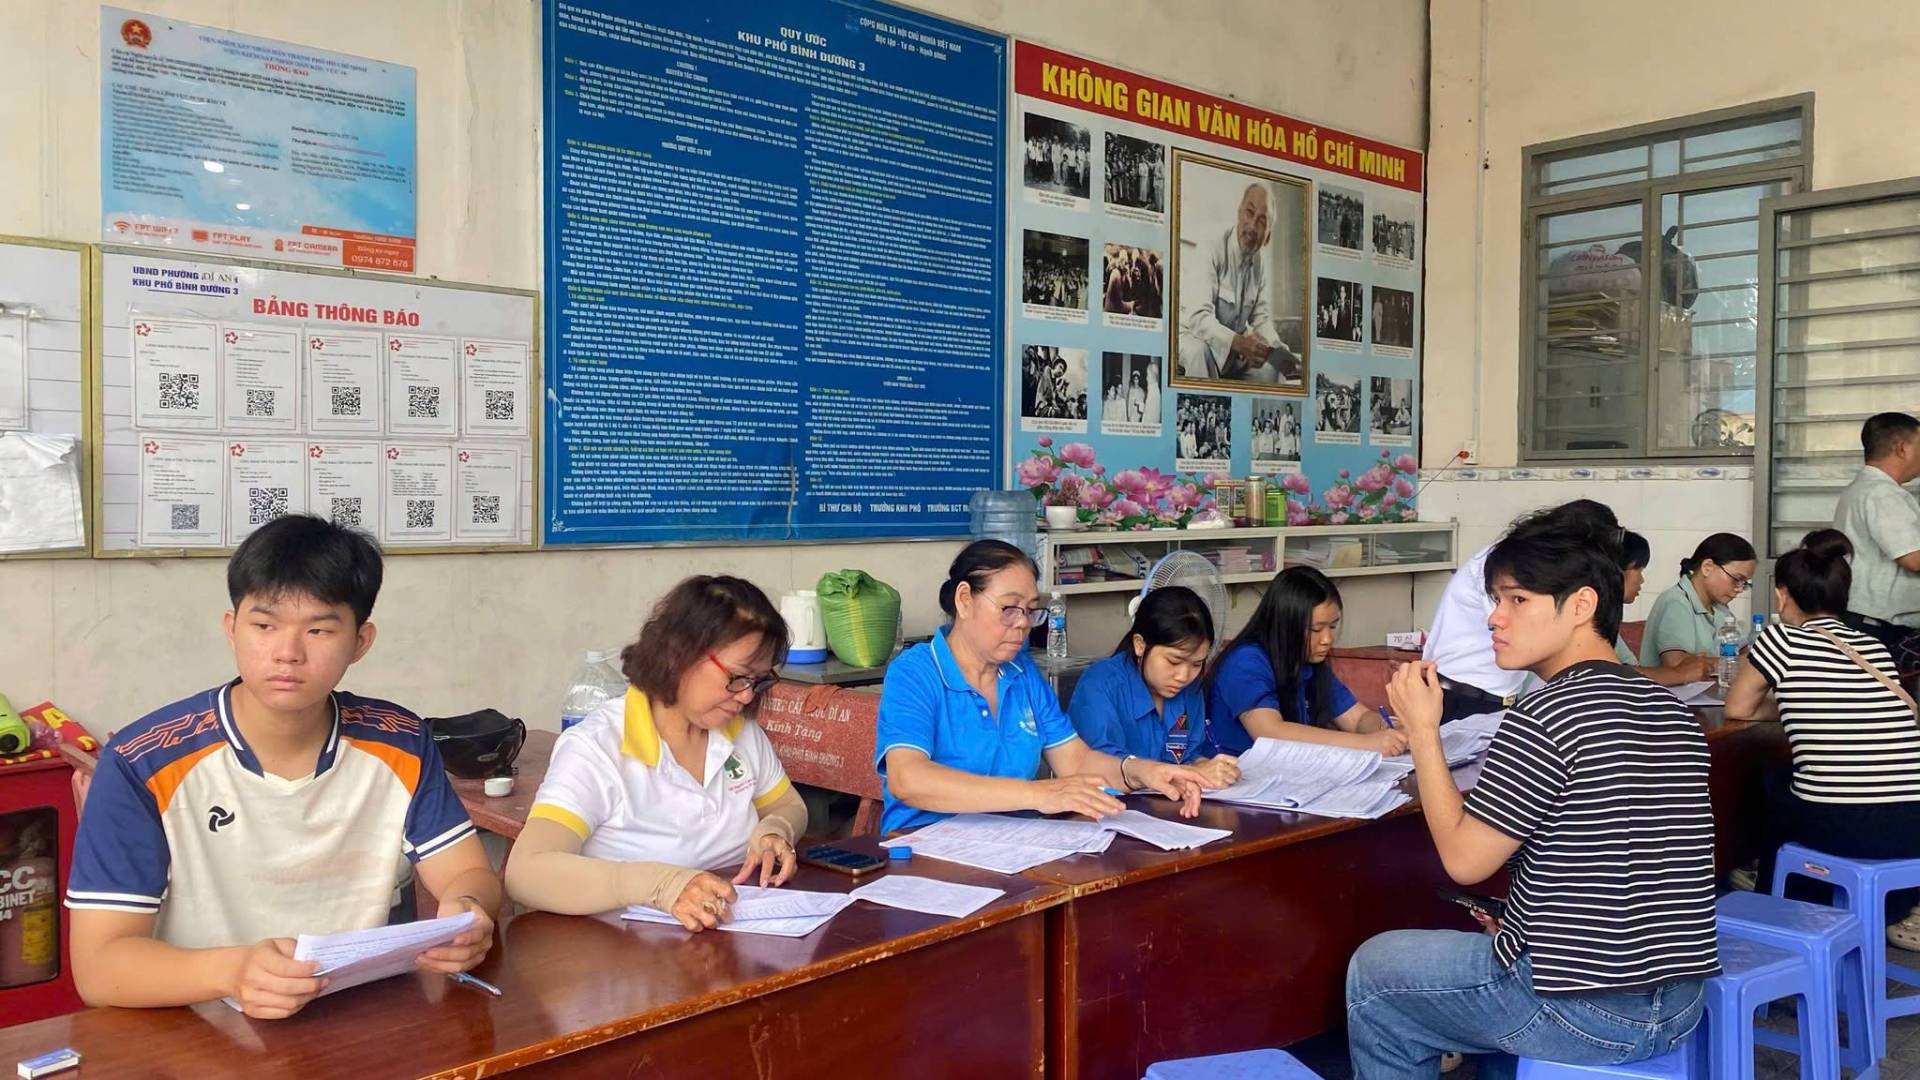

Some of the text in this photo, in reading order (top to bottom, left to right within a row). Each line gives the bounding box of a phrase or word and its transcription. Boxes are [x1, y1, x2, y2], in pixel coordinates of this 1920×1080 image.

[780, 27, 801, 40] QUY
[738, 30, 761, 45] KHU
[764, 37, 788, 52] PHỐ
[790, 43, 817, 59] BÌNH
[858, 61, 866, 72] 3
[1042, 62, 1405, 182] KHÔNG GIAN VĂN HÓA HỒ CHÍ MINH
[133, 266, 159, 276] UBND
[132, 278, 152, 287] KHU
[154, 278, 173, 289] PHỐ
[176, 281, 198, 292] BÌNH
[253, 295, 420, 327] BẢNG THÔNG BÁO
